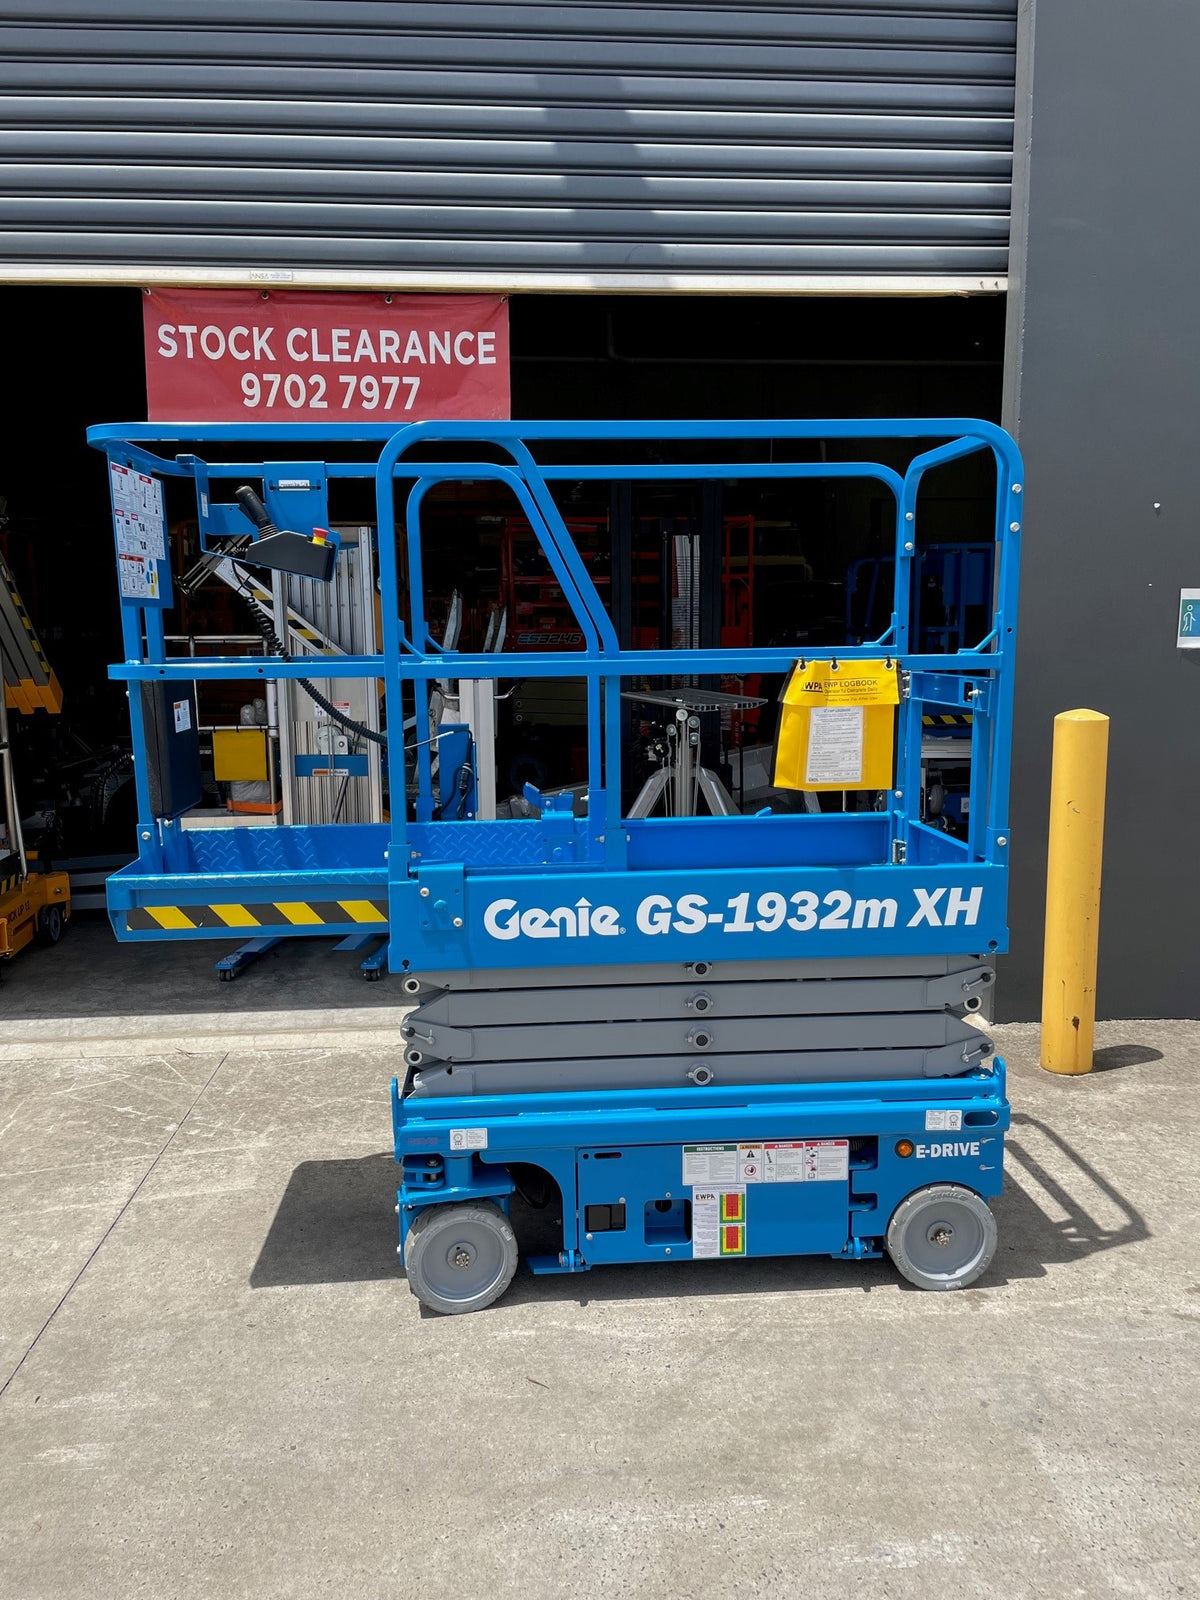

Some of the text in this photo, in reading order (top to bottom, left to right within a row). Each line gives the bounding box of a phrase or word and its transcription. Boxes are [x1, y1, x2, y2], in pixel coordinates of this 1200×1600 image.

[157, 324, 497, 366] STOCK CLEARANCE
[240, 373, 421, 411] 9702 7977
[518, 632, 582, 645] ES3246
[840, 680, 878, 688] LOGBOOK
[483, 886, 984, 940] Genie GS-1932m XH
[916, 1142, 980, 1159] E-DRIVE
